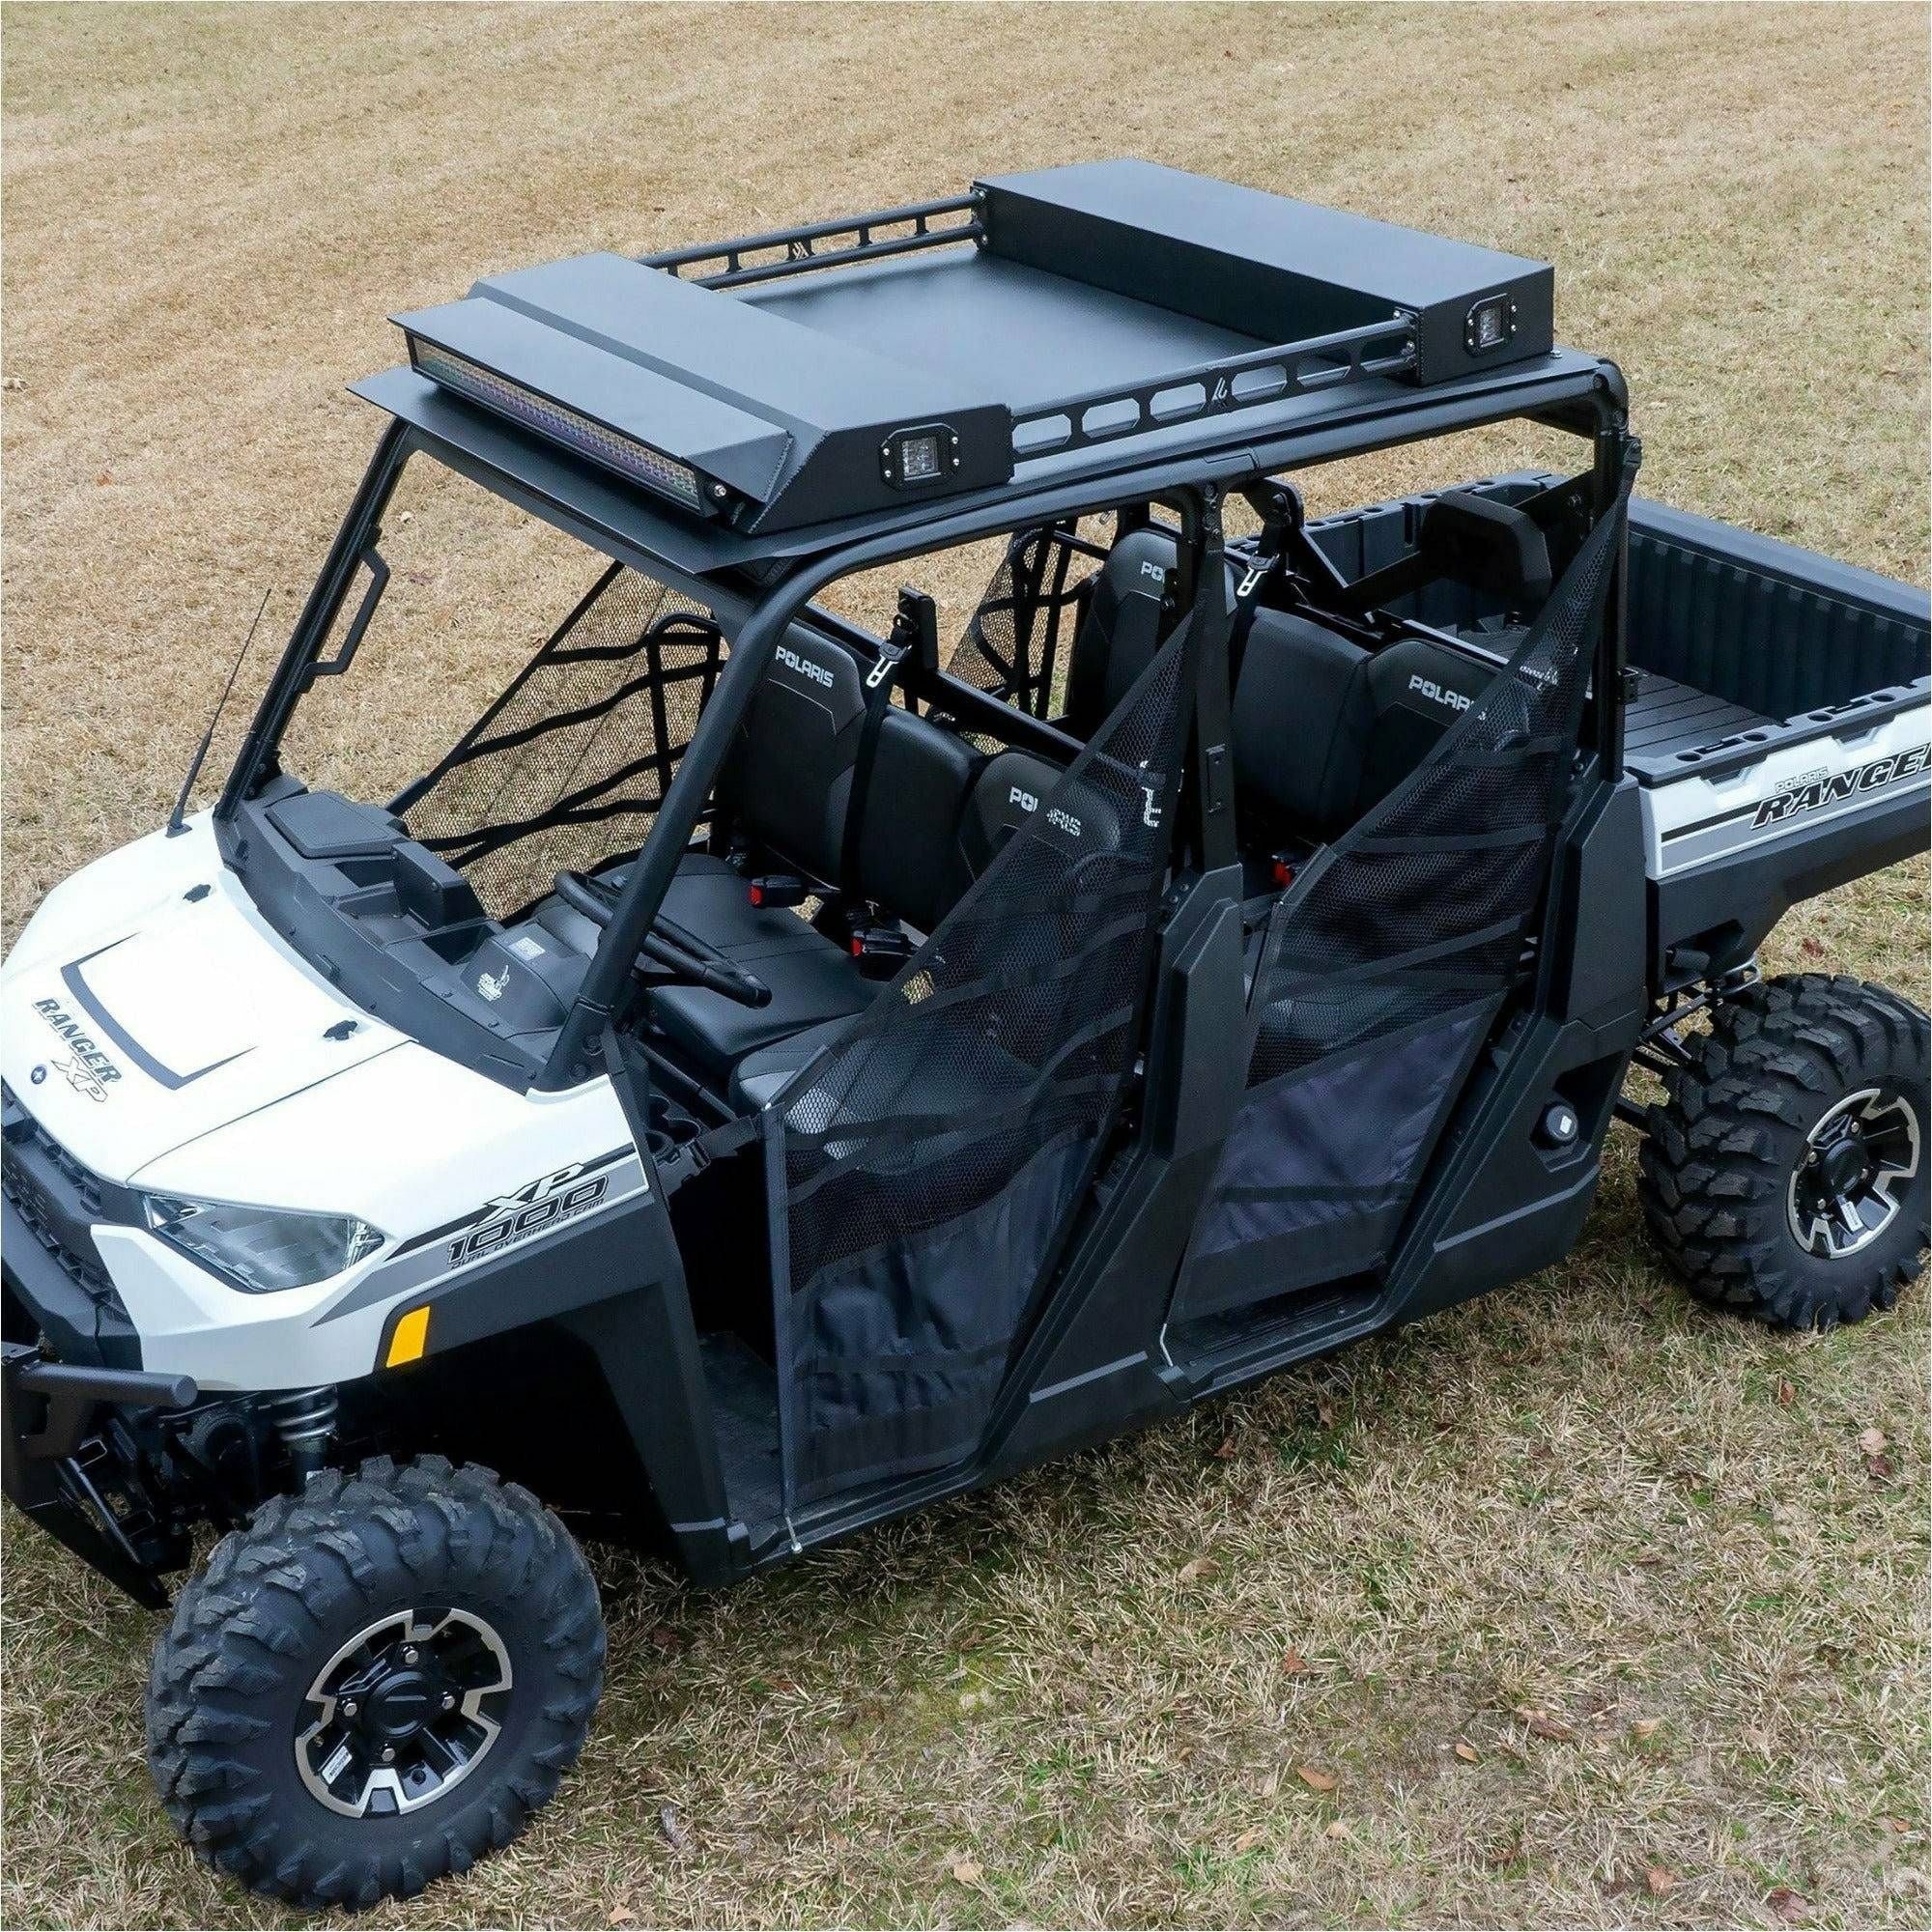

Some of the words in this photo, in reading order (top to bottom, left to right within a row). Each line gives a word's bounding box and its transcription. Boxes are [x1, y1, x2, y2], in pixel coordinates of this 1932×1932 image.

[775, 645, 835, 688] POLARIS
[1775, 766, 1829, 793] POLARIS
[33, 998, 123, 1084] RANGER
[50, 1056, 108, 1103] XP
[447, 1174, 610, 1264] 1000
[467, 1162, 585, 1231] XP
